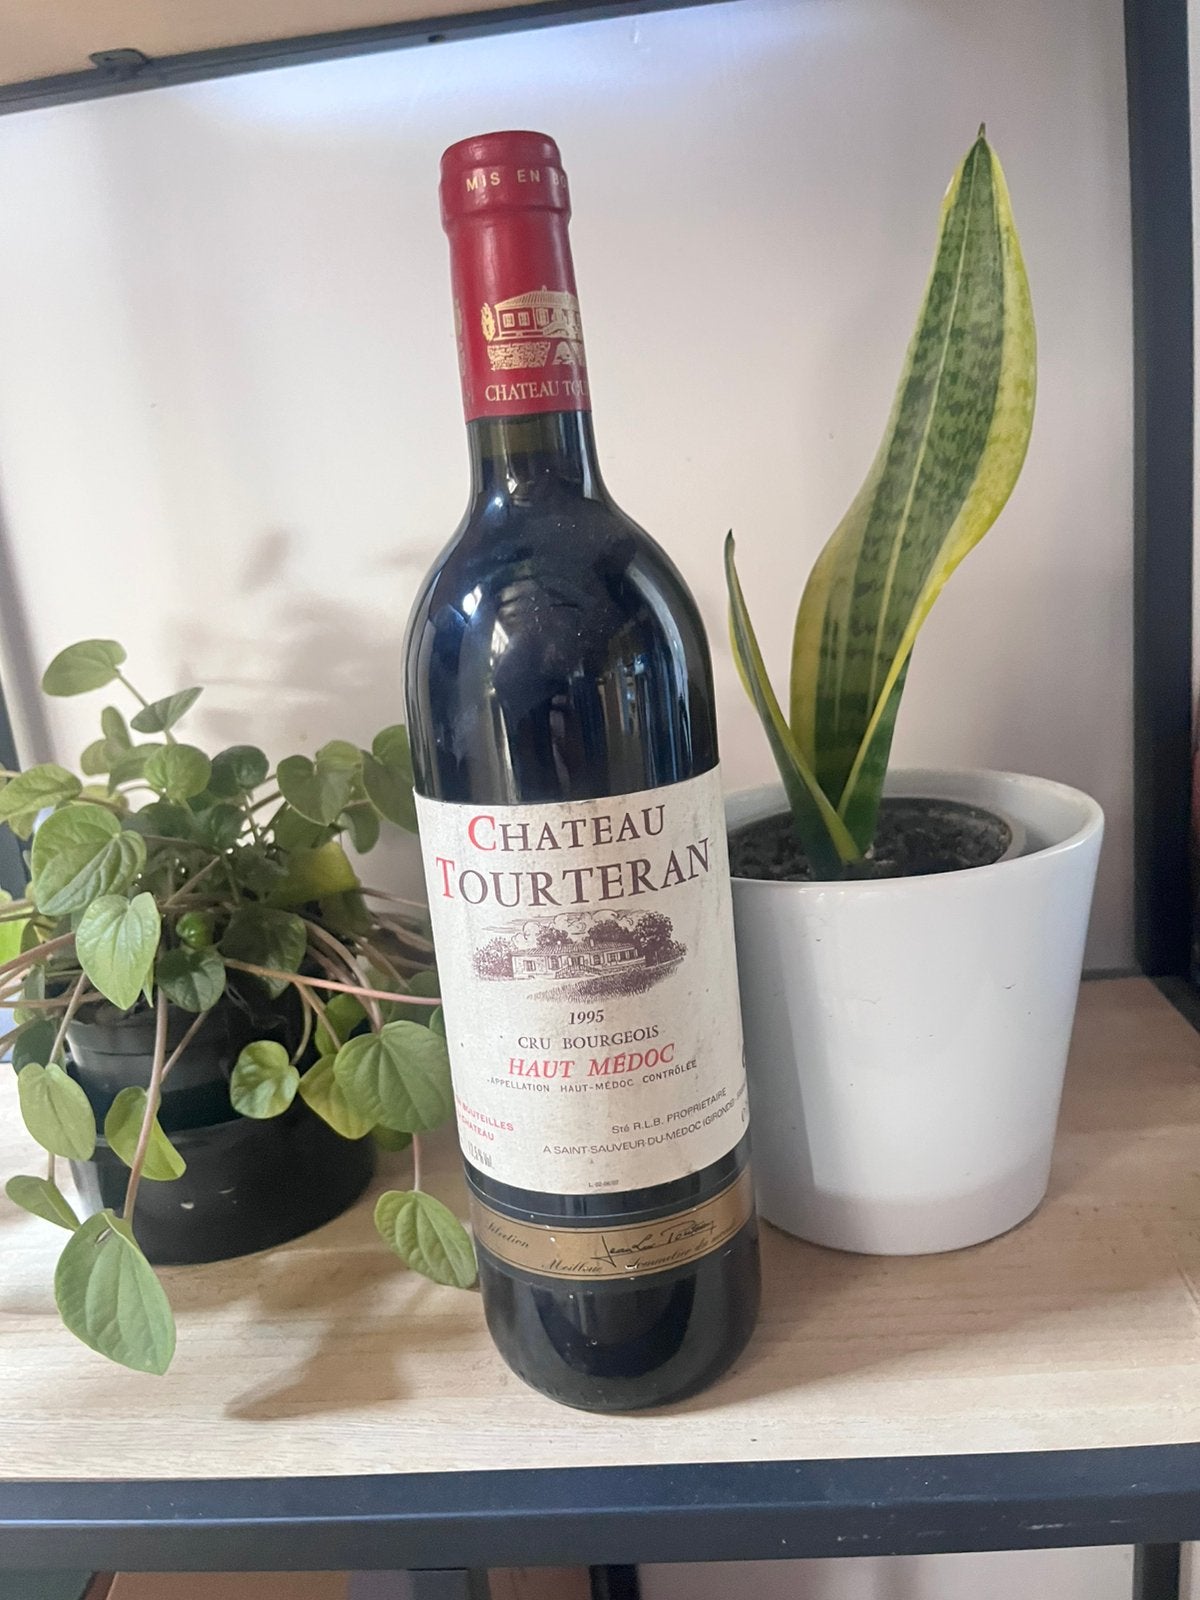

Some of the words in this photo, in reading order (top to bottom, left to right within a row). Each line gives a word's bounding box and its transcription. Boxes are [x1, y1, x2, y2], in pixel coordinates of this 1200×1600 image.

[466, 172, 501, 192] MIS
[517, 169, 540, 183] EN
[485, 380, 559, 402] CHATEAU
[468, 805, 665, 852] CHATEAU
[436, 837, 712, 908] TOURTERAN
[568, 1009, 605, 1025] 1995
[518, 1036, 551, 1050] CRU
[563, 1025, 660, 1050] BOURGEOIS
[508, 1057, 575, 1078] HAUT
